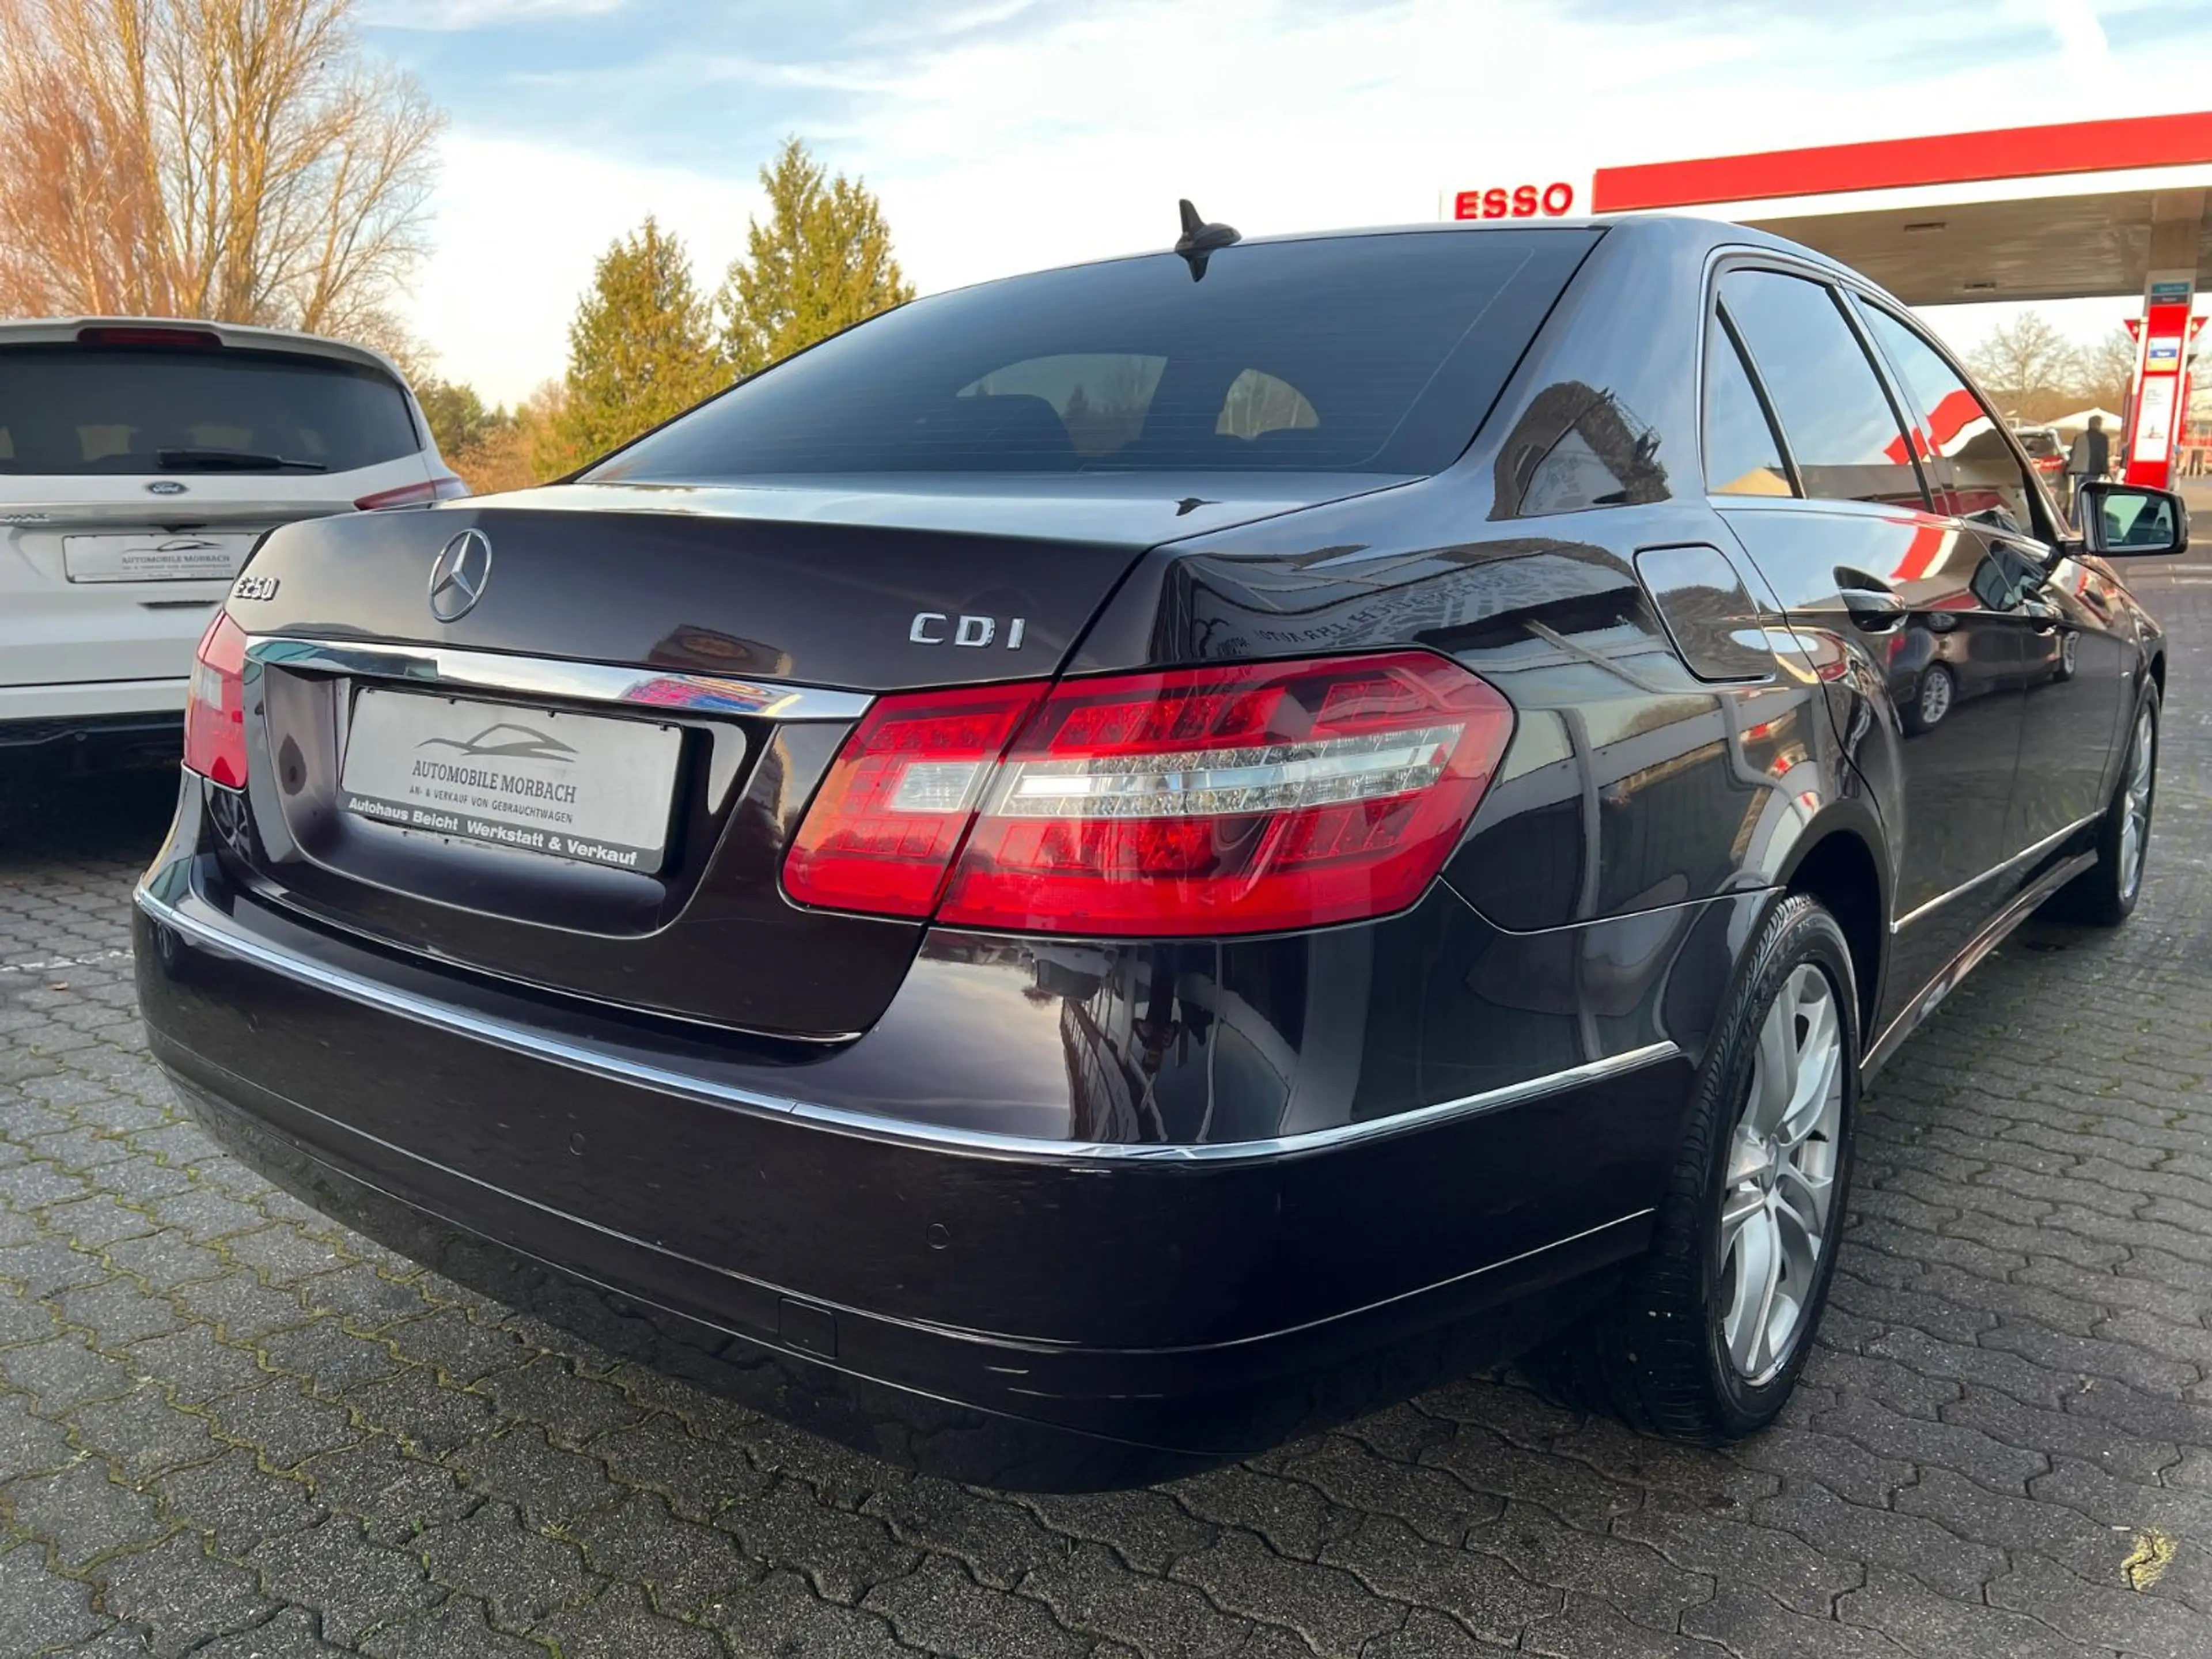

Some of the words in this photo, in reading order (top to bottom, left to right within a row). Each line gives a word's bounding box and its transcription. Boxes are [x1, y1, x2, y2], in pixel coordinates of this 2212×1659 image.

[1455, 182, 1574, 219] ESSO
[233, 577, 278, 600] E250
[910, 612, 1025, 650] CDI
[412, 760, 498, 790] AUTOMOBILE
[500, 775, 577, 804] MORBACH
[426, 788, 430, 797] &
[434, 789, 468, 804] VERKAUF
[471, 796, 489, 808] VON
[492, 800, 573, 823] GEBRAUCHTWAGEN
[349, 797, 409, 821] Autohaus
[412, 810, 459, 830] Beicht
[467, 819, 544, 848] Werkstatt
[548, 836, 562, 851] &
[567, 839, 638, 865] Verkauf
